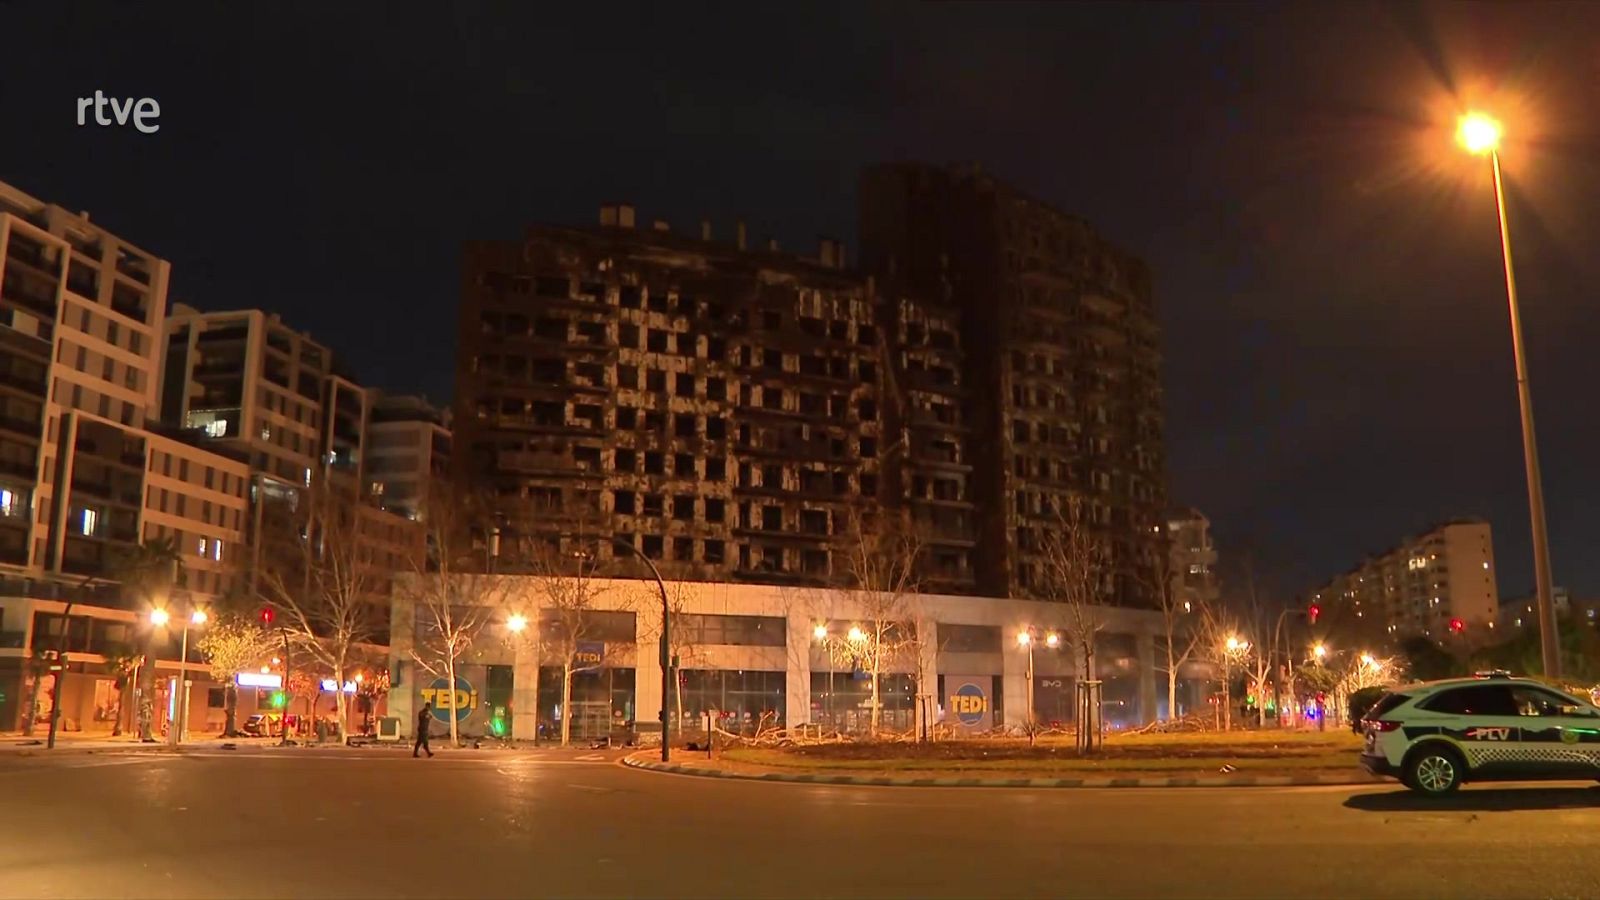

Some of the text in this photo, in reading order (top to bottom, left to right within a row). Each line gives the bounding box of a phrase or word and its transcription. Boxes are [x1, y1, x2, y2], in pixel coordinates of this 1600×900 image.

[420, 688, 478, 710] TEDi
[950, 695, 988, 713] TEDi
[1476, 727, 1509, 740] PLV
